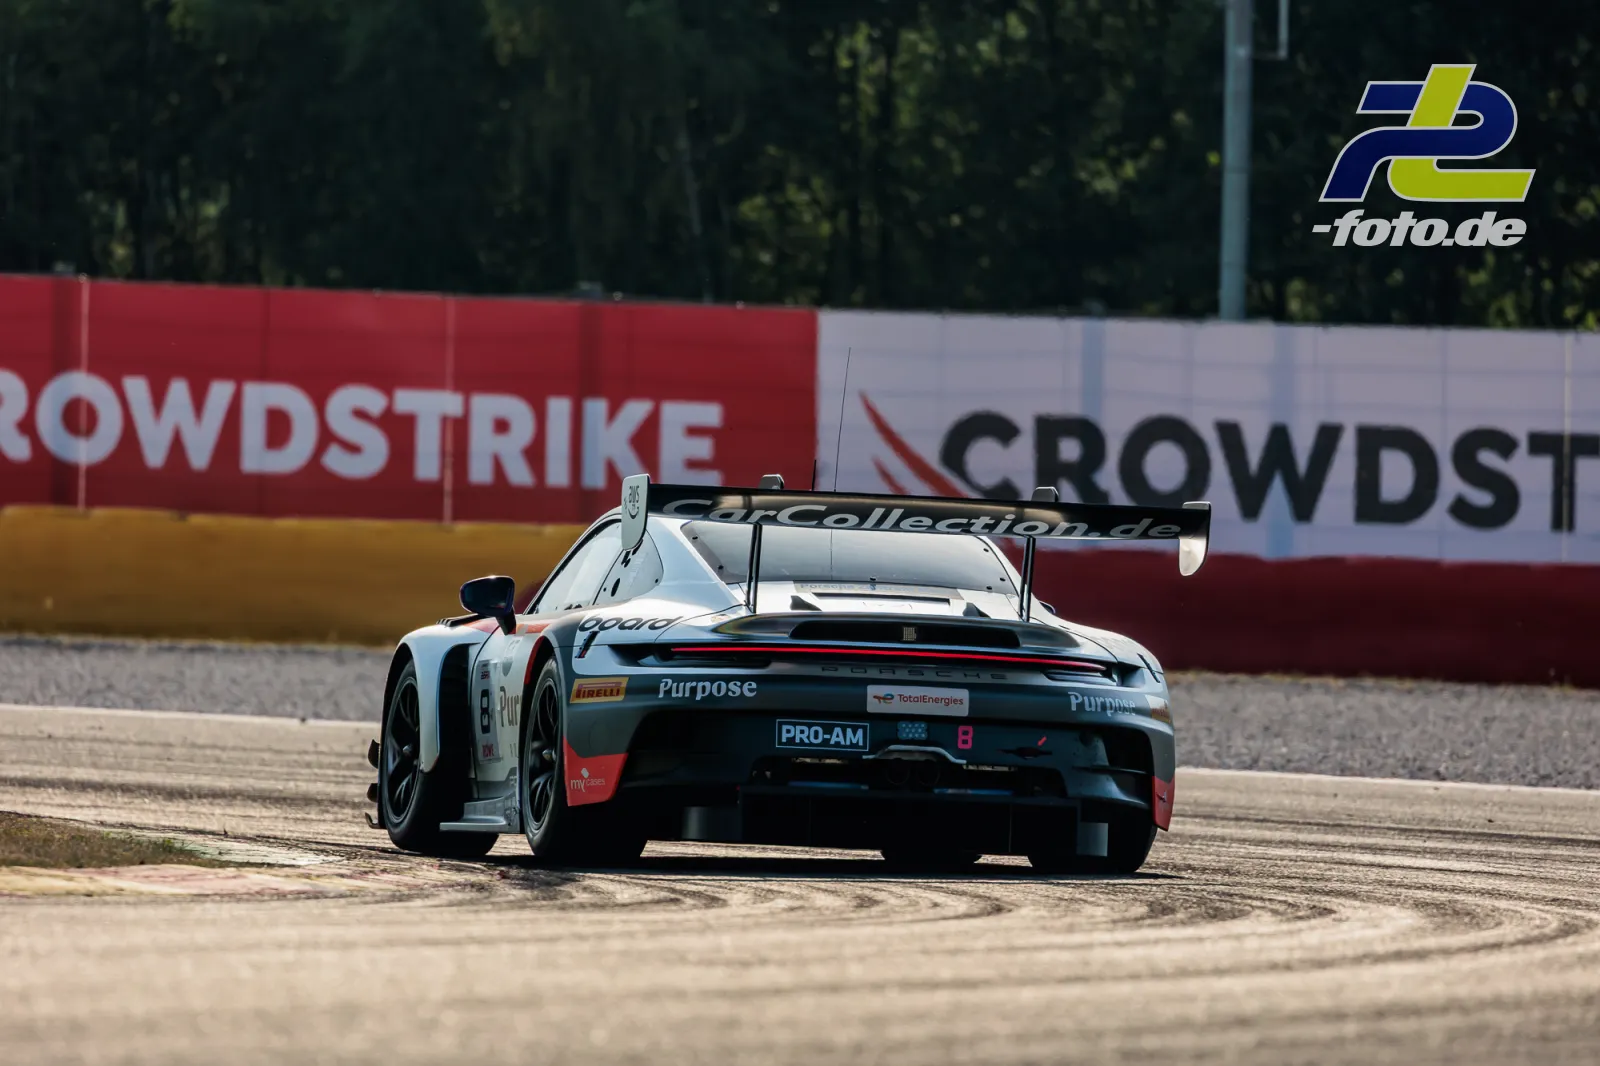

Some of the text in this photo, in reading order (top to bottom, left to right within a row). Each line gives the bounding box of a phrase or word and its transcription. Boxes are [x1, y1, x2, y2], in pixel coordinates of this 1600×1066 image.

[940, 410, 1600, 533] CROWDST
[662, 498, 1182, 540] CarCollection.de
[578, 614, 683, 632] board
[821, 665, 1008, 680] PORSCHE
[575, 682, 623, 699] PIRELLI
[658, 678, 758, 701] Purpose
[897, 693, 964, 707] TotalEnergies
[480, 689, 491, 734] 8
[1068, 691, 1136, 717] Purpose
[781, 724, 864, 747] PRO-AM
[957, 724, 974, 750] 8
